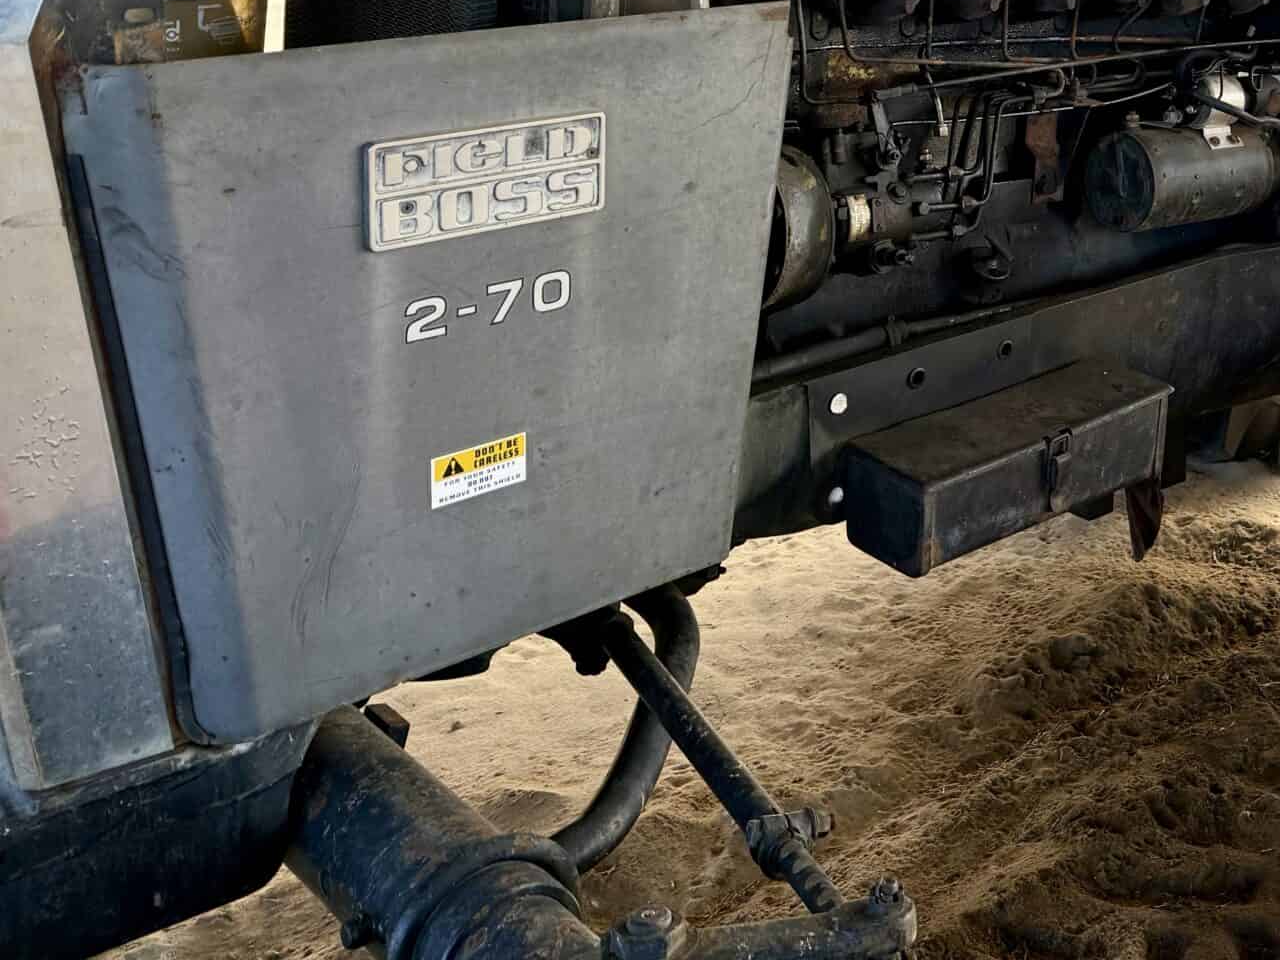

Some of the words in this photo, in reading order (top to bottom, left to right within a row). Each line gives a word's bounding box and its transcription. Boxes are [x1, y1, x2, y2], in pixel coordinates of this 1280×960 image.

[381, 168, 596, 243] BOSS
[404, 269, 572, 344] 2-70
[473, 447, 520, 469] CARELESS
[474, 441, 503, 458] DON'T
[506, 437, 519, 449] BE
